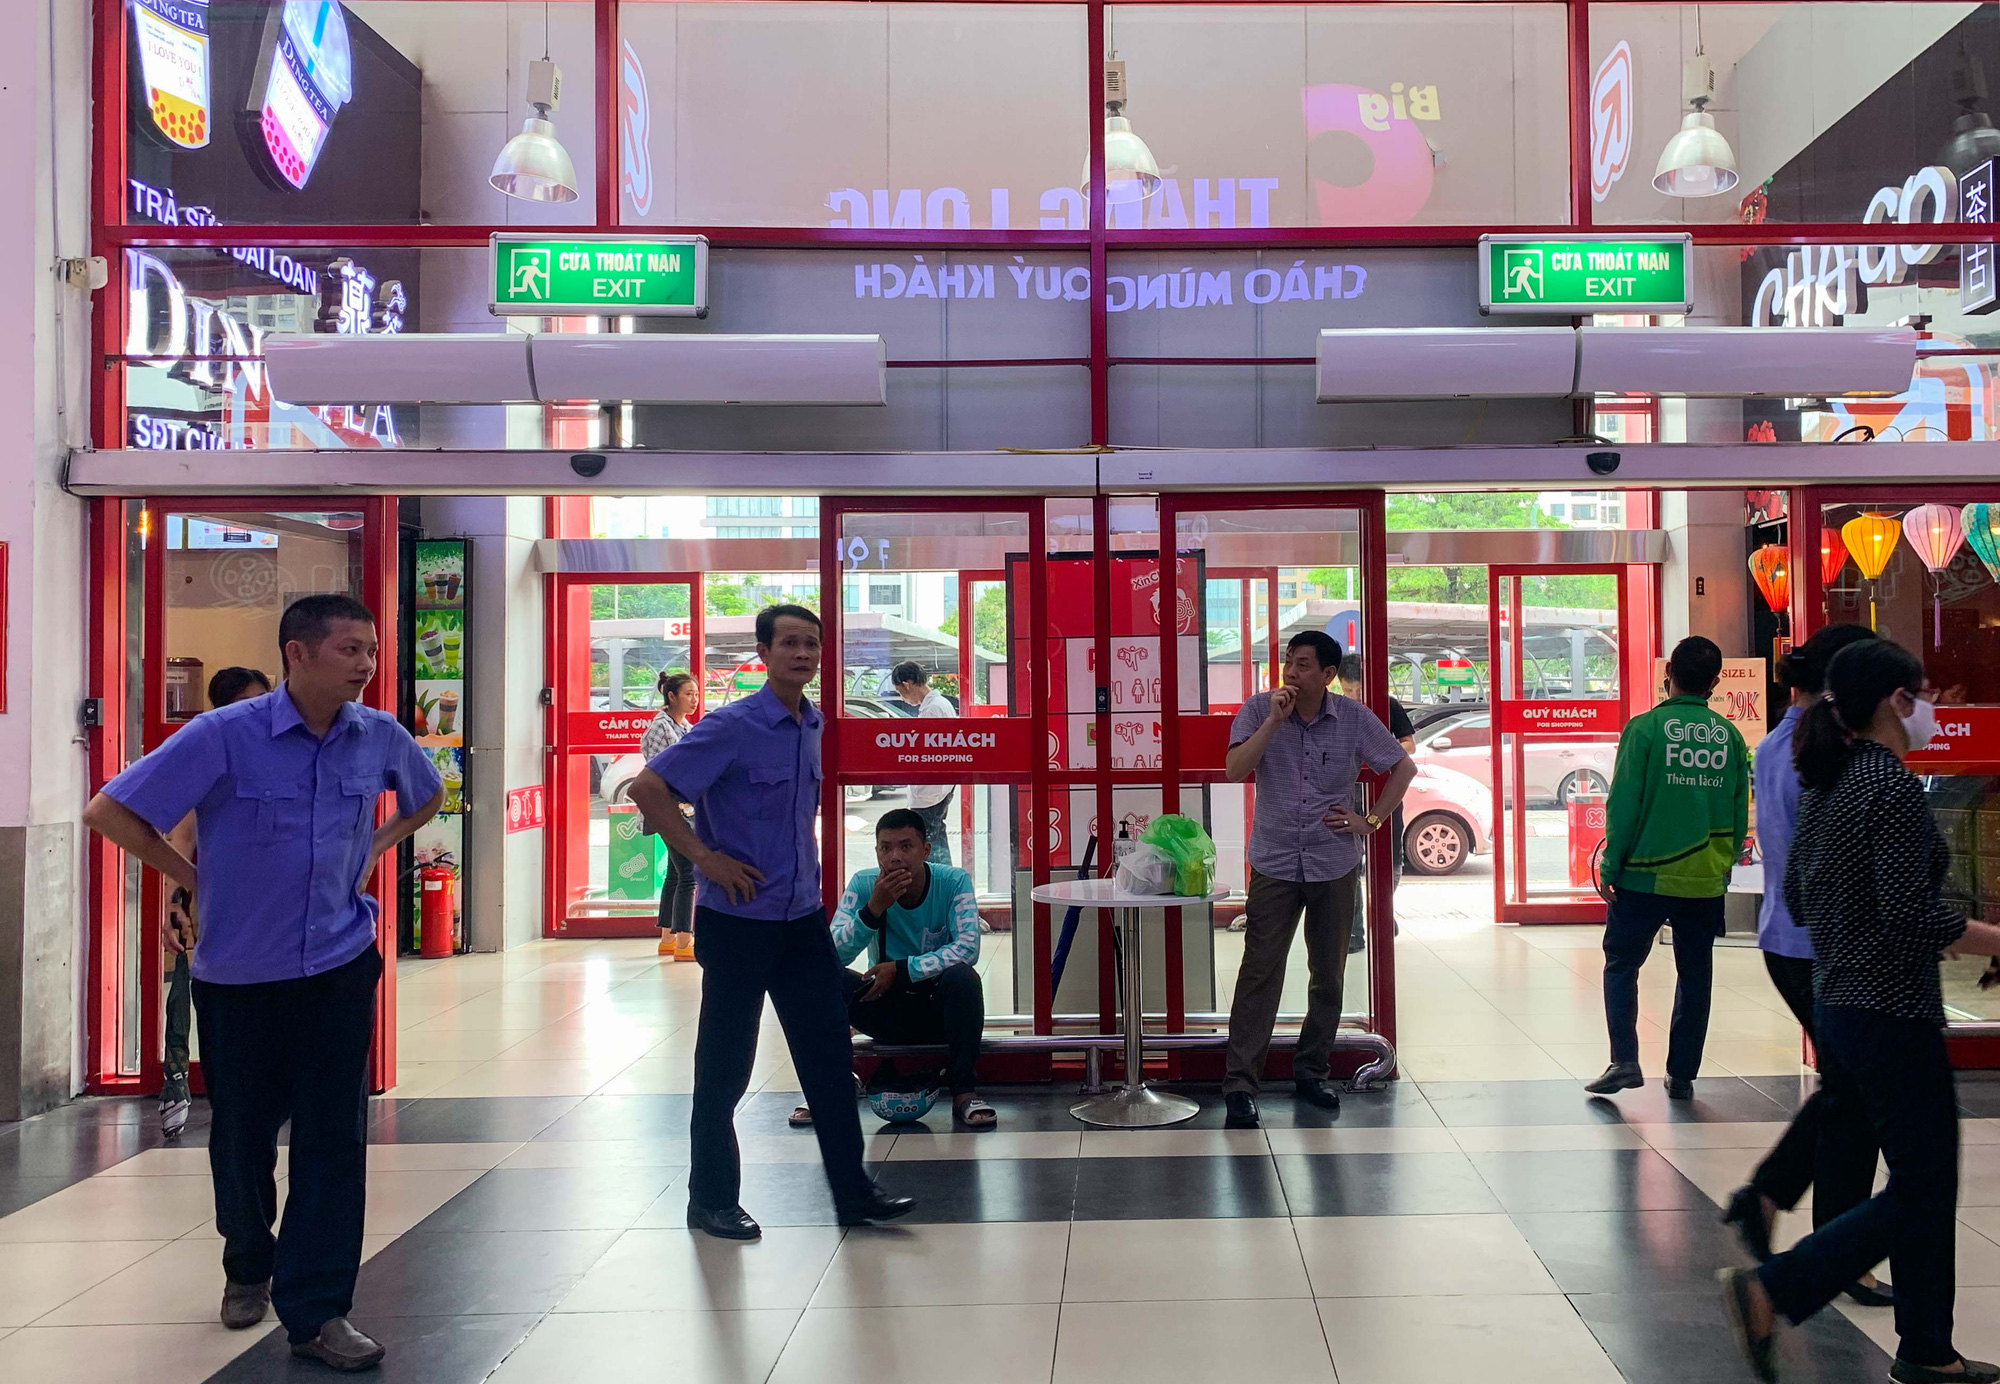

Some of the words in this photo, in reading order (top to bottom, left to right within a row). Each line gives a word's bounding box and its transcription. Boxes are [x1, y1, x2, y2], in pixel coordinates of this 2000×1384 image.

[154, 43, 177, 65] LOVE
[179, 56, 196, 74] YOU
[130, 178, 180, 226] TRÀ
[268, 247, 317, 296] LOAN
[558, 246, 591, 271] CỬA
[595, 247, 643, 272] THOÁT
[647, 253, 681, 277] NẠN
[1551, 246, 1583, 271] CỬA
[1586, 247, 1633, 271] THOÁT
[1637, 252, 1670, 275] NẠN
[592, 278, 646, 298] EXIT
[1585, 277, 1637, 297] EXIT
[126, 248, 294, 411] DIN
[136, 414, 182, 450] SĐT
[1721, 669, 1746, 678] SIZE
[1748, 669, 1756, 678] L
[1522, 707, 1551, 719] QUÝ
[1552, 706, 1597, 719] KHÁCH
[1726, 691, 1761, 721] 29K
[598, 716, 629, 730] CẢM
[1664, 717, 1729, 744] Grab
[1931, 720, 1971, 737] ÁCH
[875, 729, 920, 748] QUÝ
[924, 729, 996, 748] KHÁCH
[898, 754, 919, 763] FOR
[921, 754, 974, 763] SHOPPING
[1666, 743, 1728, 770] Food
[1666, 772, 1696, 786] Thèm
